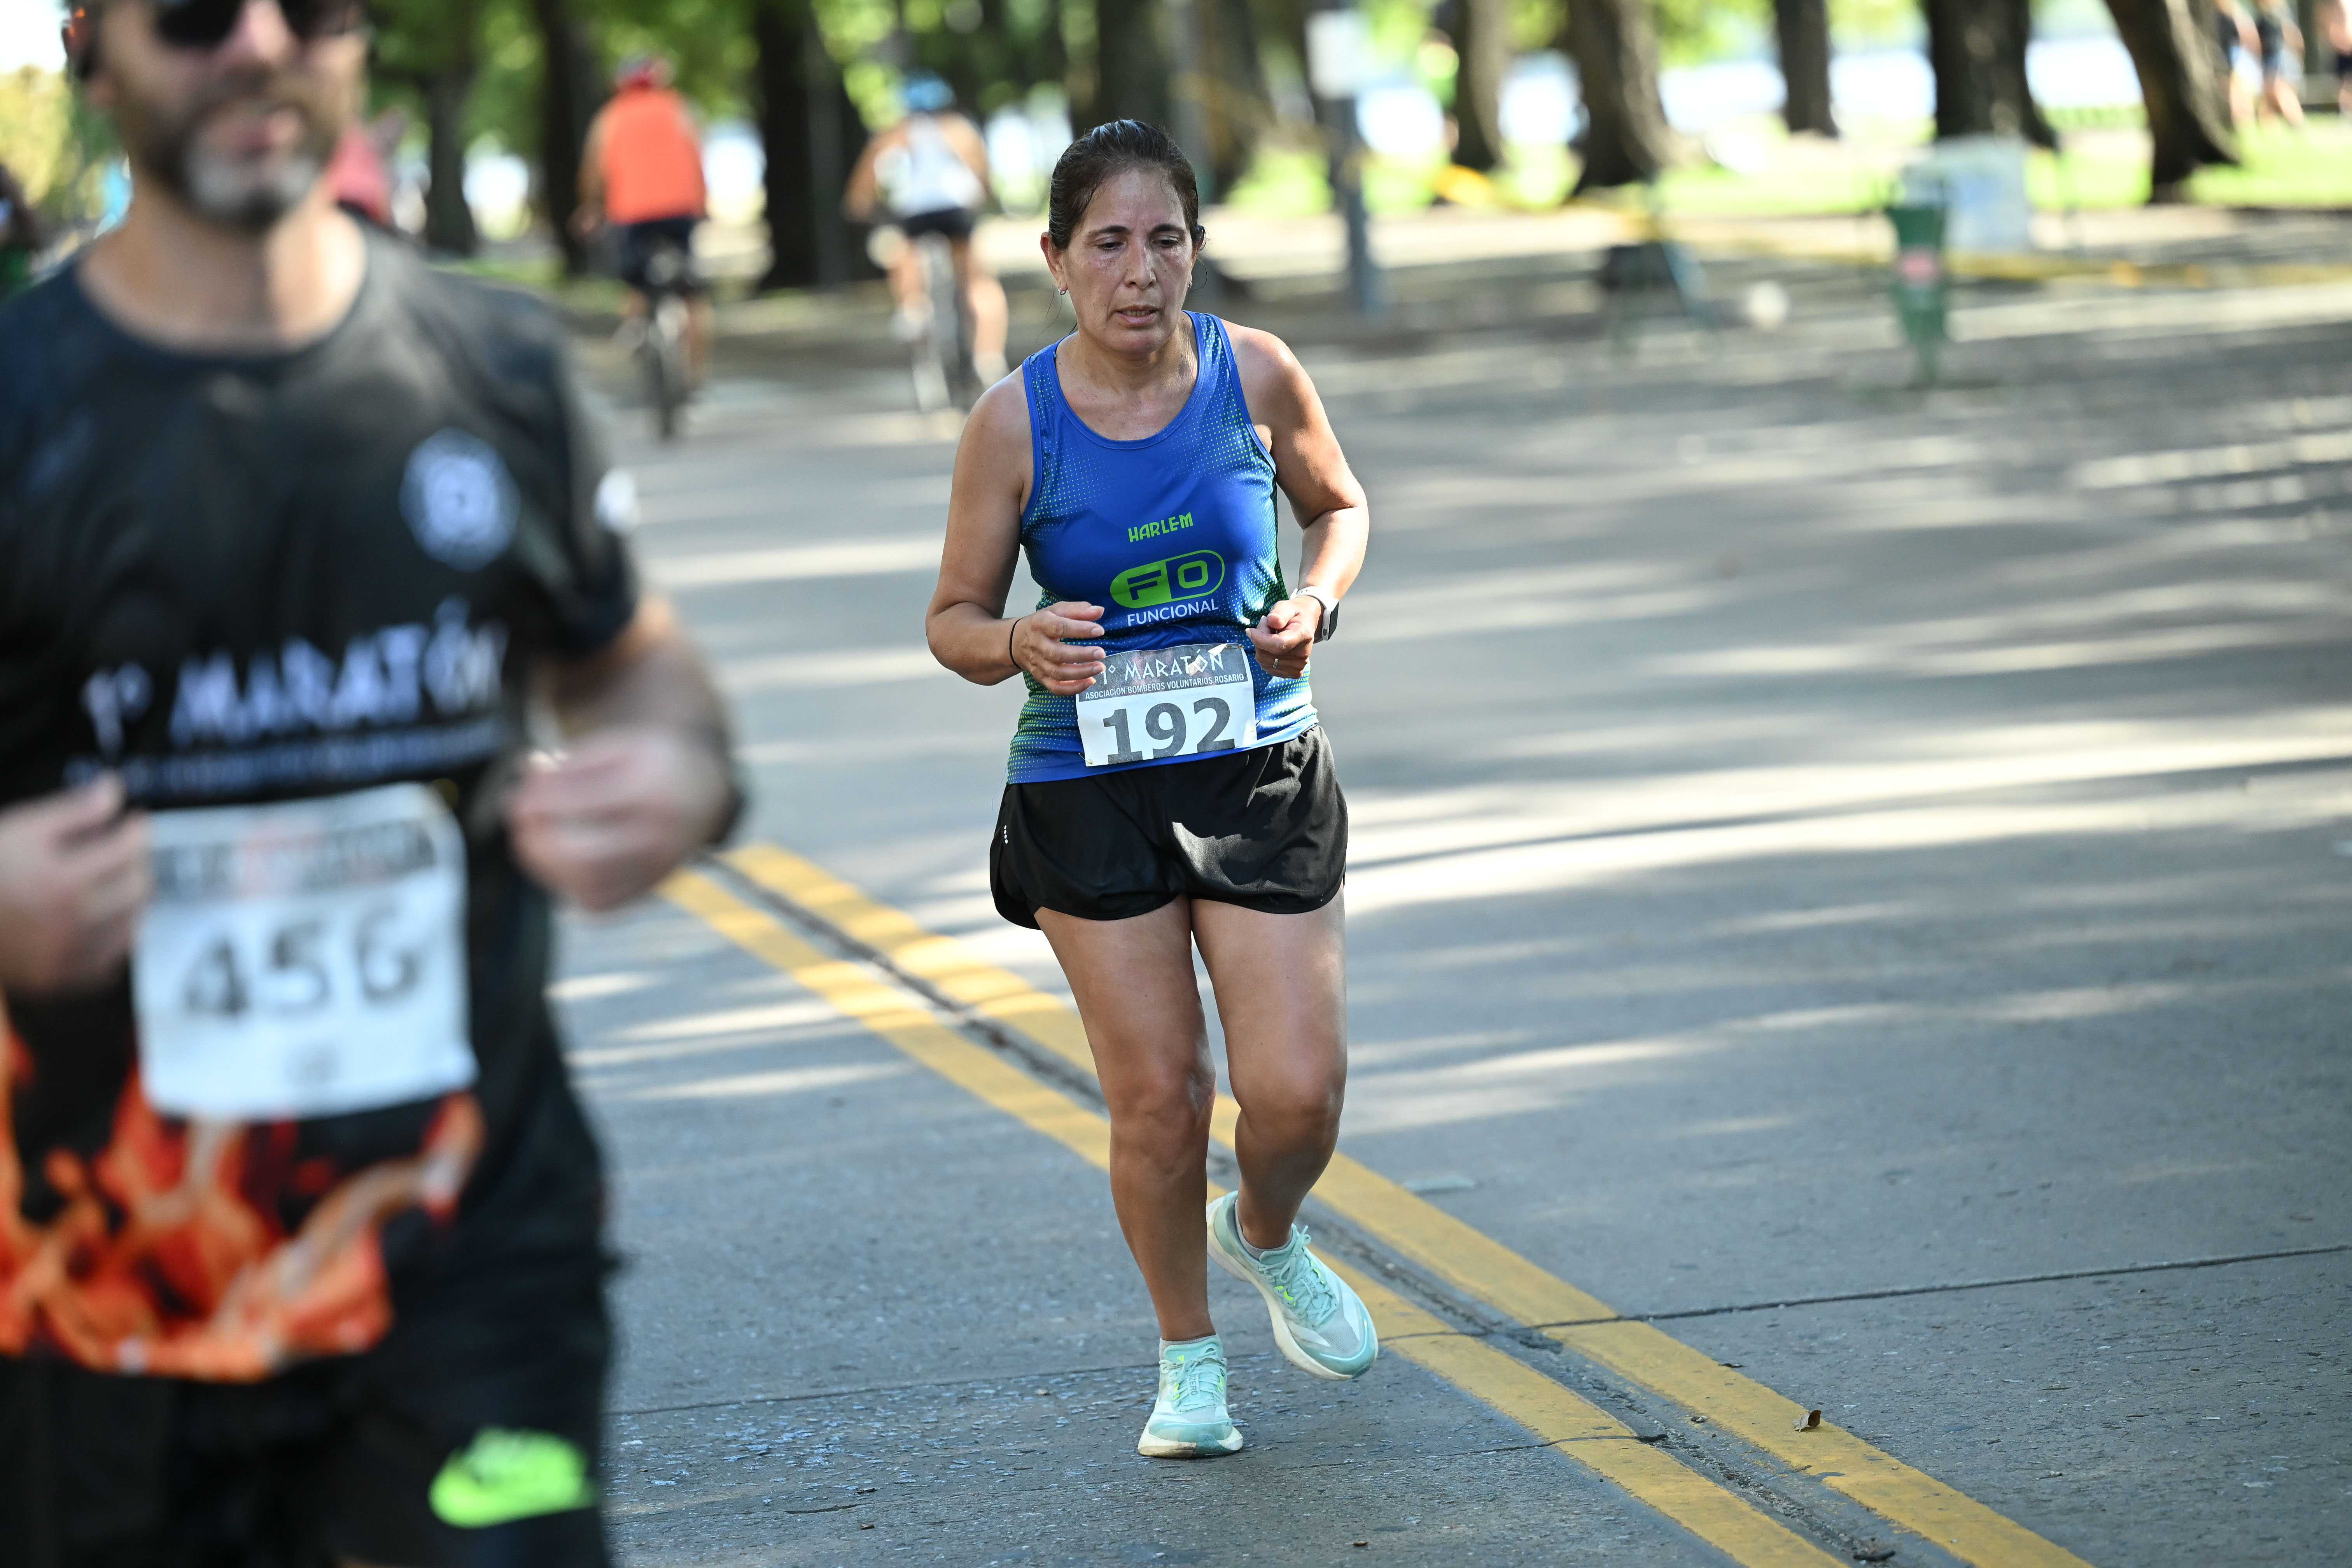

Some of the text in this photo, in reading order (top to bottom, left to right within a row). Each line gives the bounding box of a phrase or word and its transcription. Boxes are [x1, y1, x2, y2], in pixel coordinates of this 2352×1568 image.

[1128, 512, 1193, 542] HARLEM
[1127, 599, 1219, 627] FUNCIONAL
[1124, 648, 1224, 681] MARATÓN
[1085, 673, 1244, 700] ASOCIACIÓN BOMBEROS VOLUNTARIOS ROSARIO
[1103, 697, 1235, 765] 192
[182, 906, 426, 1022] 456
